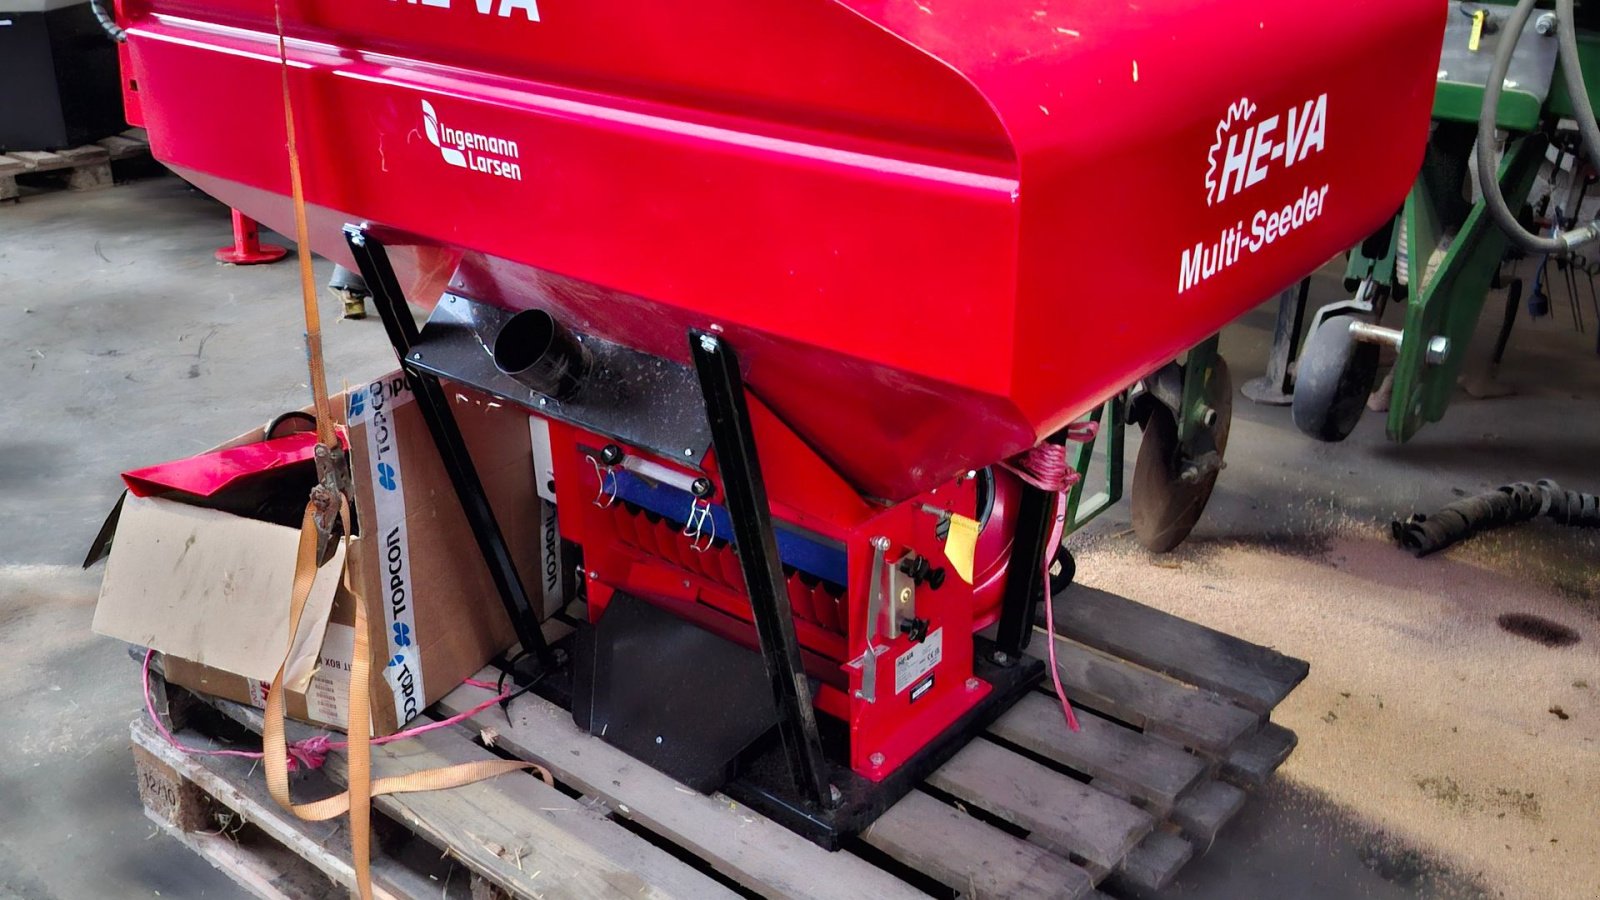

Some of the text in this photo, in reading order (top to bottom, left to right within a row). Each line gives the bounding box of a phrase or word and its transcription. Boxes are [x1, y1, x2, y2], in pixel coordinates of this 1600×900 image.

[440, 122, 519, 158] Ingemann
[468, 149, 522, 181] Larsen
[1216, 93, 1328, 204] HE-VA
[1178, 183, 1329, 294] Multi-Seeder
[370, 380, 391, 461] TOPCO
[387, 526, 406, 621] TOPCON
[325, 658, 341, 669] BOX
[396, 663, 418, 723] TOPCO
